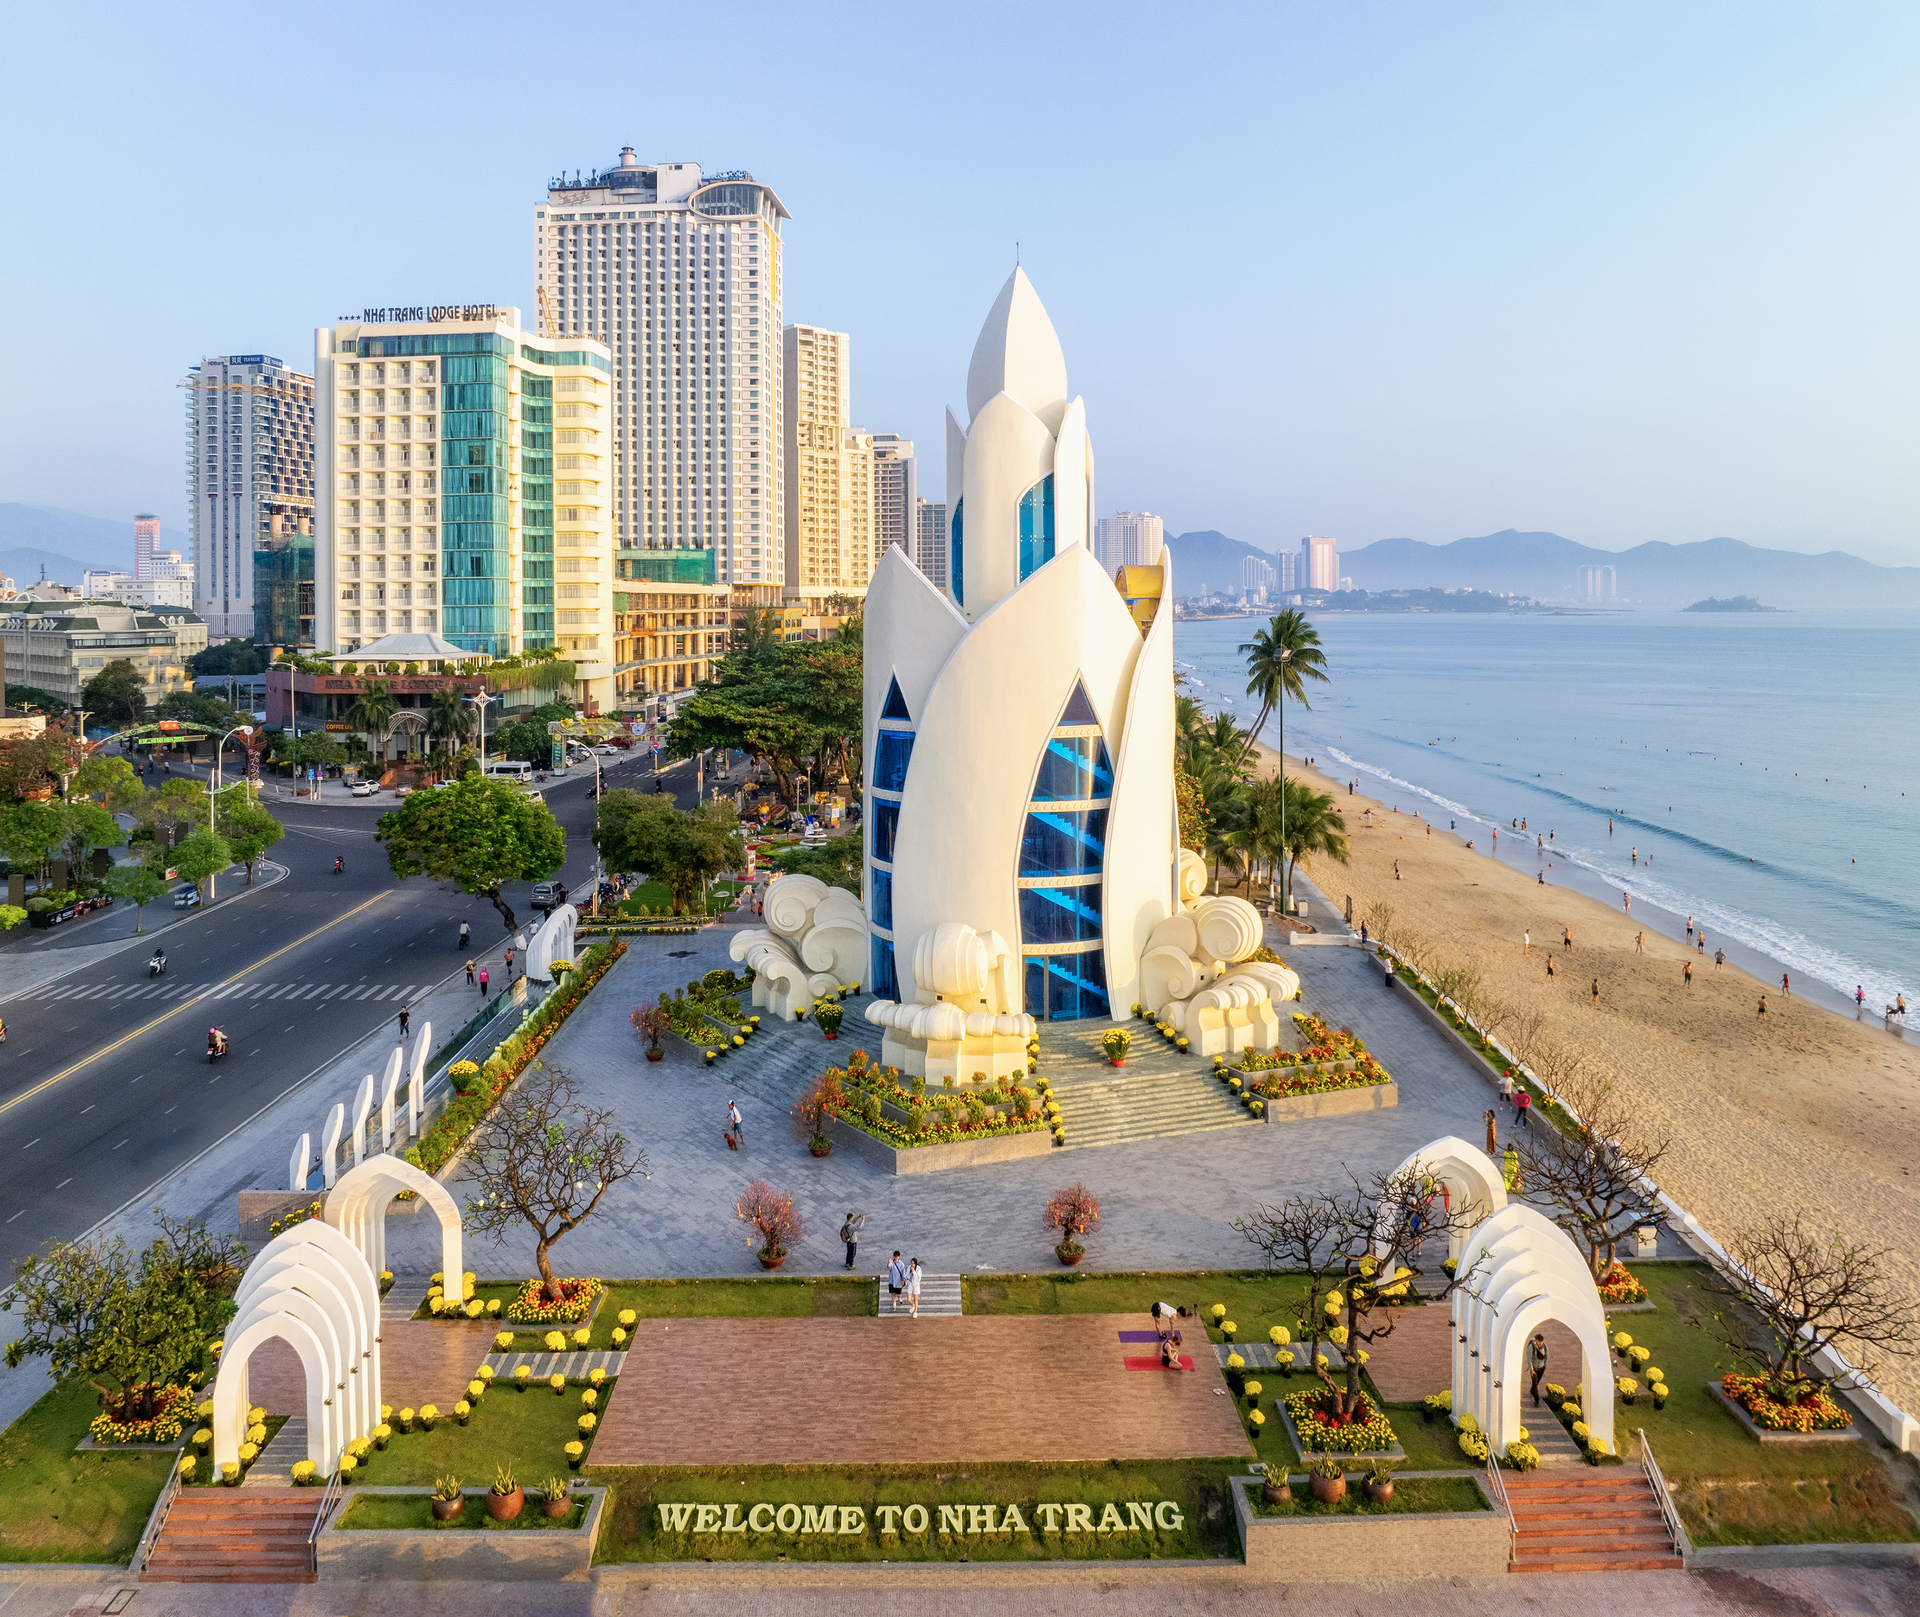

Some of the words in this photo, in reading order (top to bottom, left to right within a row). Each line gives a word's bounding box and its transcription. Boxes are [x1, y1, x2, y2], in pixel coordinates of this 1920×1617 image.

[363, 307, 385, 323] NHA
[388, 306, 423, 323] TRANG
[427, 305, 460, 321] LODGE
[463, 304, 497, 319] HOTEL
[325, 680, 353, 689] NHA
[657, 1503, 866, 1534] WELCOME
[875, 1503, 929, 1534] TO
[938, 1503, 1030, 1534] NHA
[1036, 1501, 1185, 1533] TRANG
